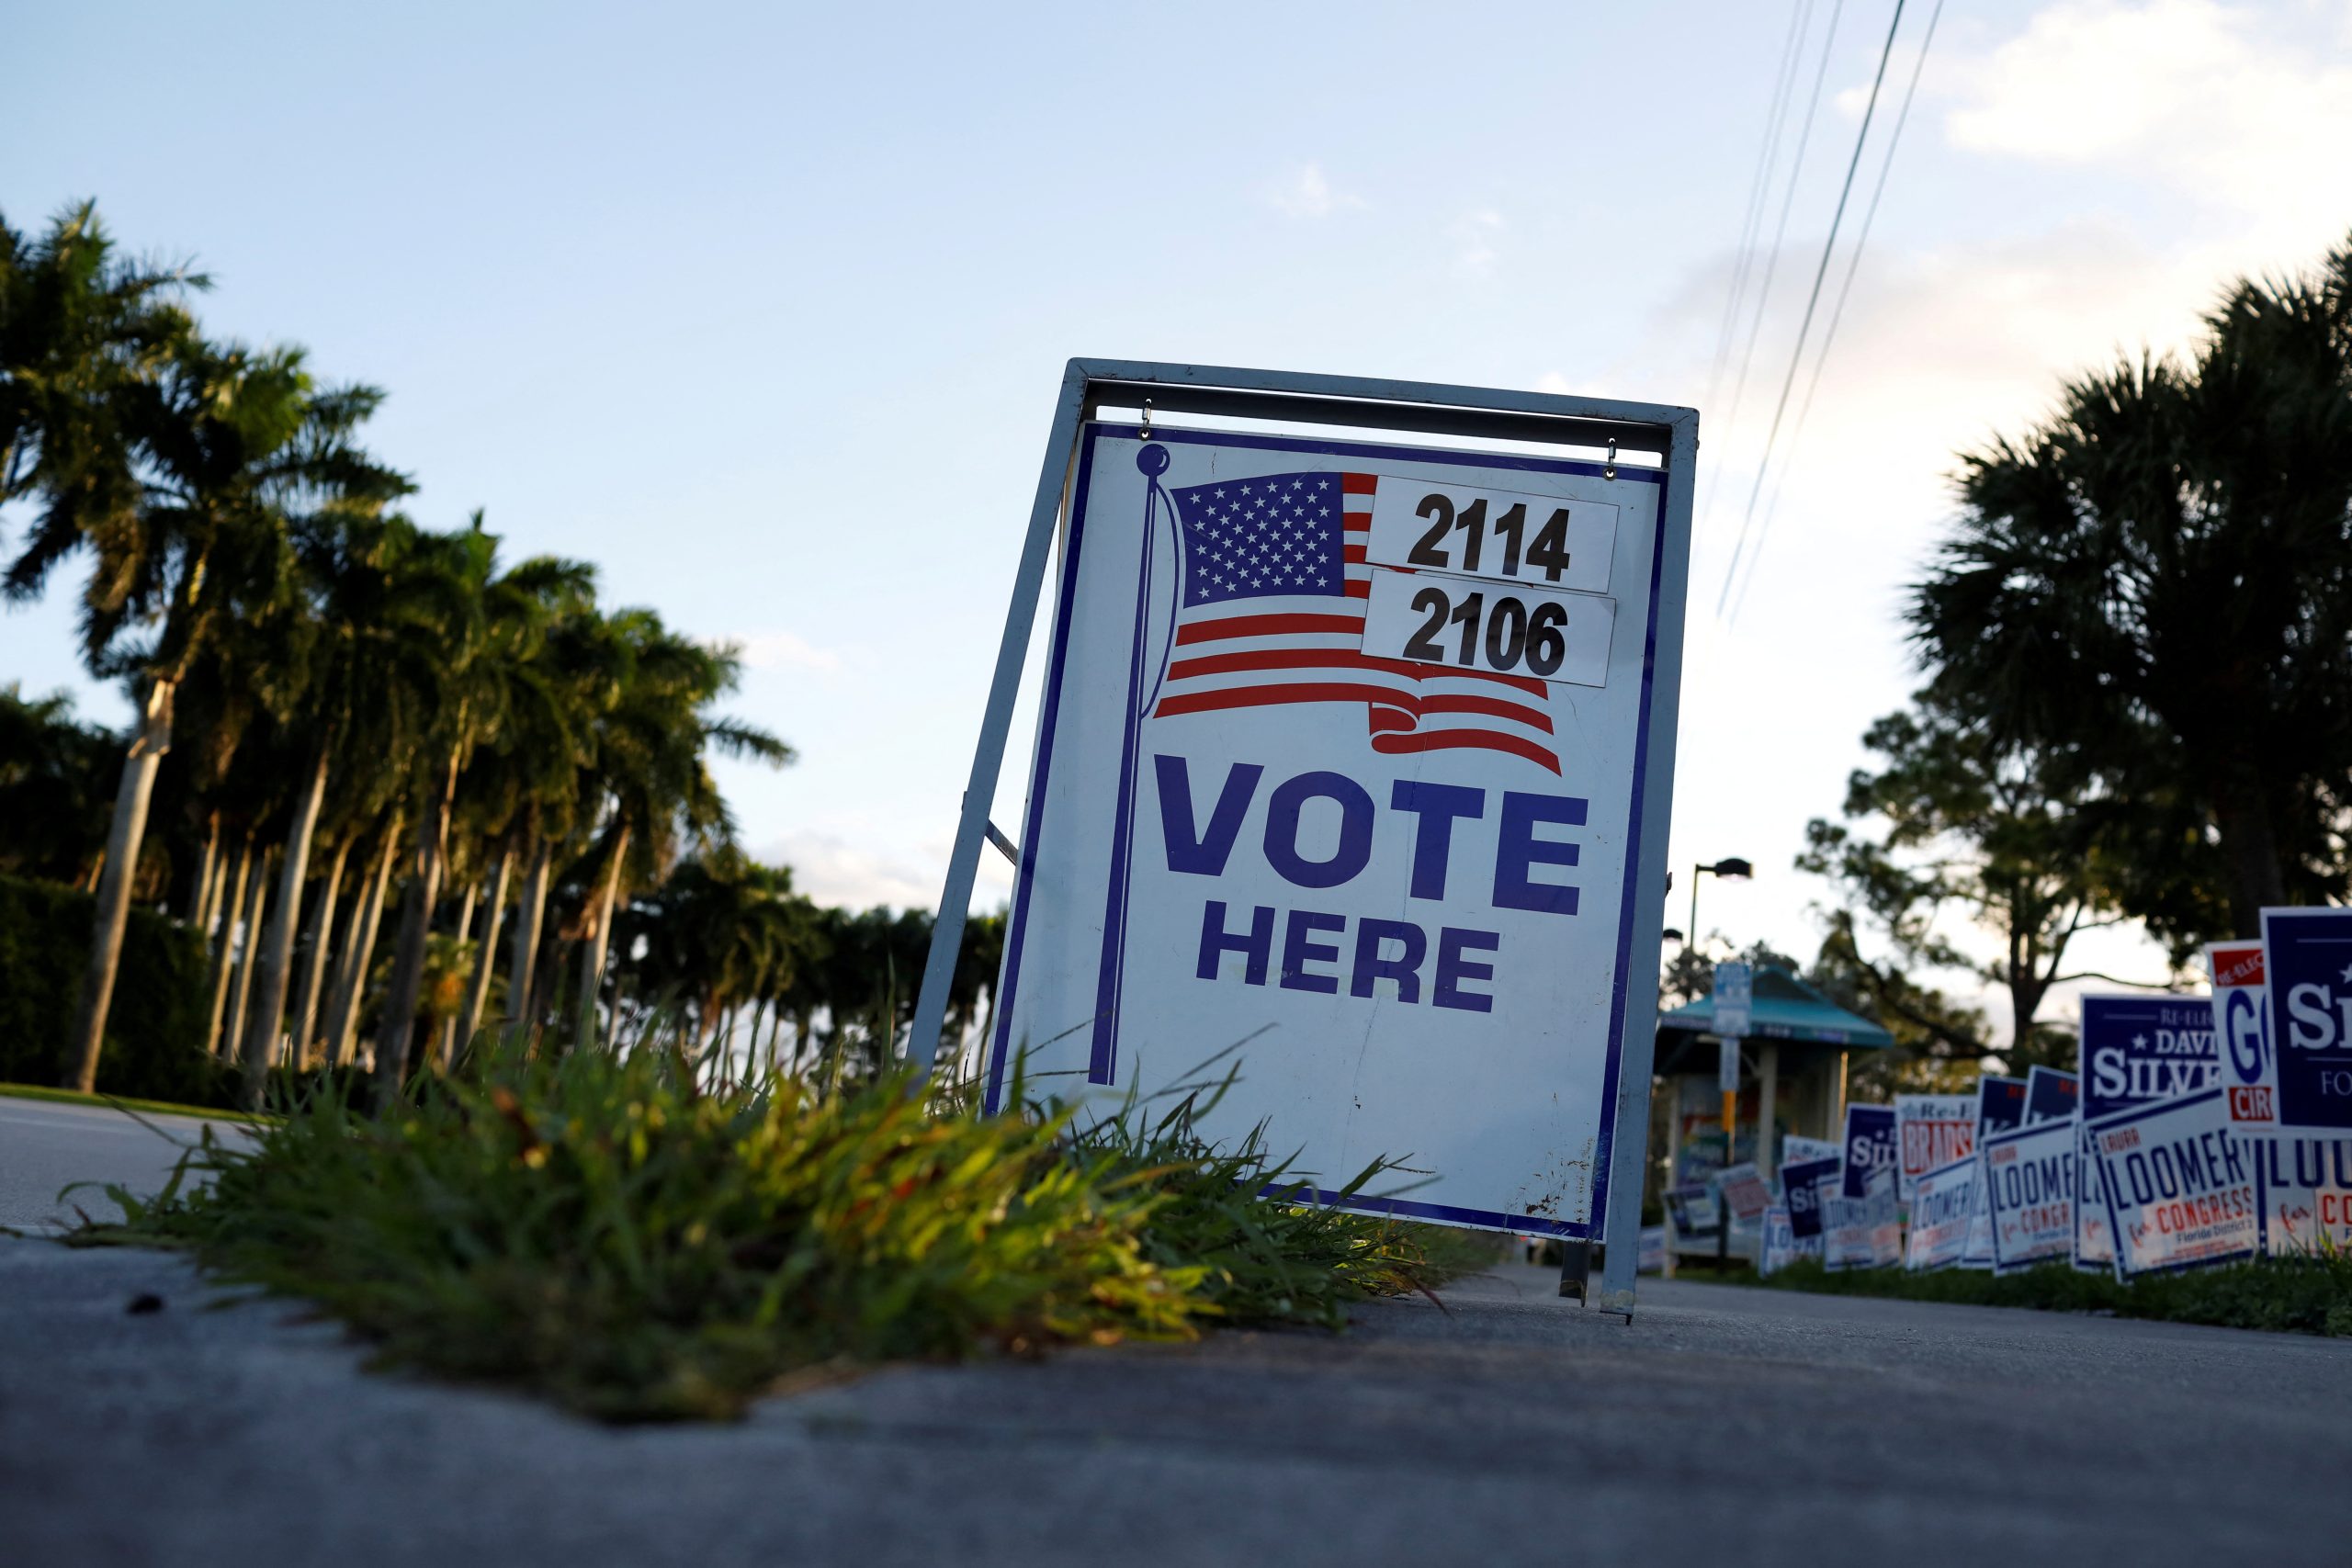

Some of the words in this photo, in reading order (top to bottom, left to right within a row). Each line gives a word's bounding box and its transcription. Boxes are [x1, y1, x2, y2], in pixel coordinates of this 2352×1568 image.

[1407, 493, 1569, 581] 2114
[1402, 587, 1567, 677] 2106
[1153, 753, 1589, 917] VOTE
[1196, 900, 1499, 1013] HERE
[2226, 989, 2271, 1084] G
[2107, 1128, 2246, 1211] LOOMER
